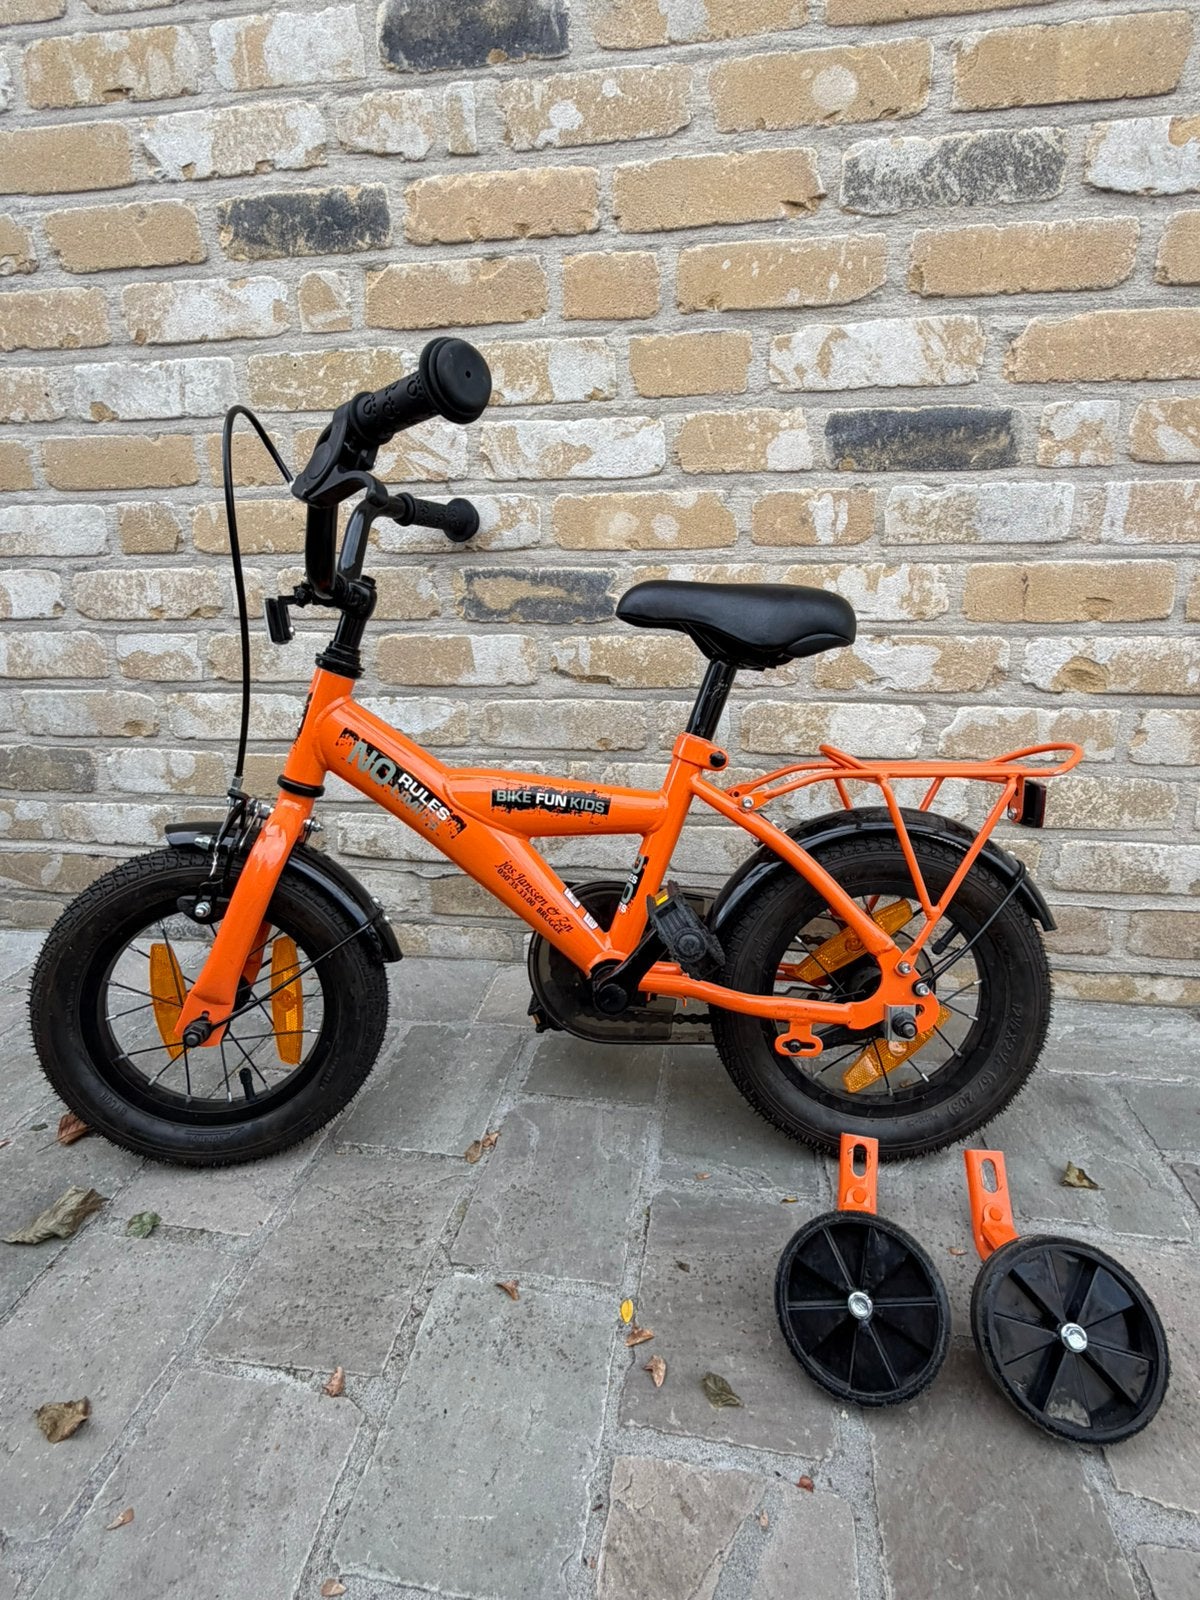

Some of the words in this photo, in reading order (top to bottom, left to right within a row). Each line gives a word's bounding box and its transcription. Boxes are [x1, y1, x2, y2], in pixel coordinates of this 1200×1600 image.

[347, 740, 397, 785] NO
[397, 772, 450, 821] RULES
[496, 790, 532, 803] BIKE
[535, 792, 567, 807] FUN
[569, 796, 606, 813] KIDS
[514, 873, 548, 907] Janssen
[546, 906, 561, 916] &
[536, 906, 565, 935] BRUGGE
